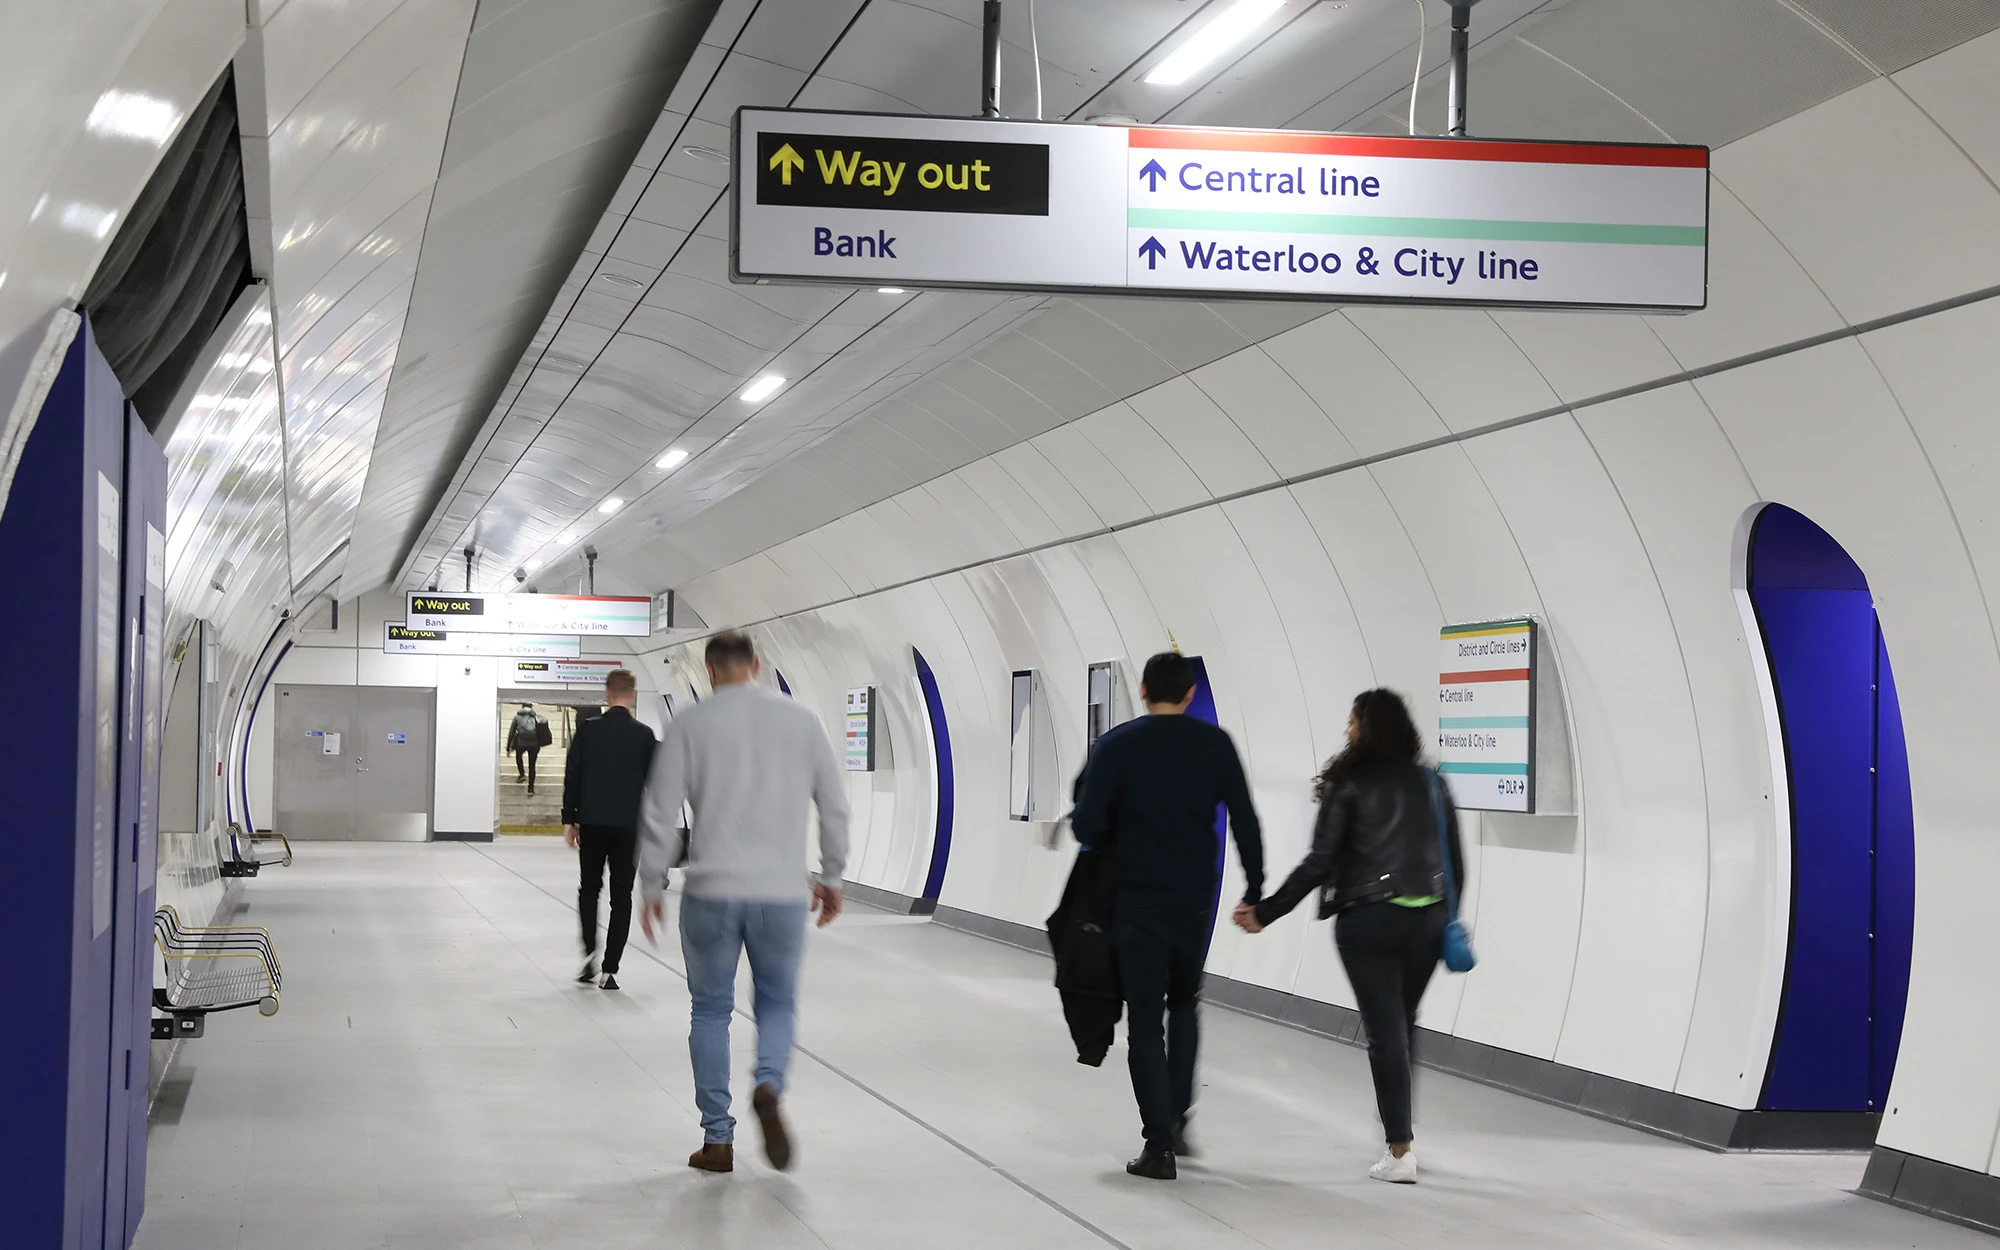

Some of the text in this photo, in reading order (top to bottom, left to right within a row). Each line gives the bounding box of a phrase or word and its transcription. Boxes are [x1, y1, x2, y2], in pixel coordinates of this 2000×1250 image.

[814, 149, 991, 196] Way out
[1178, 162, 1380, 198] Central line
[813, 226, 897, 259] Bank
[1179, 240, 1539, 285] Waterloo & City line
[426, 600, 470, 612] Way out
[425, 618, 446, 627] Bank
[571, 622, 590, 632] City
[592, 622, 608, 631] line
[516, 645, 531, 654] City
[1458, 640, 1520, 657] District and Circle lines
[1444, 688, 1473, 702] Central line
[1444, 733, 1496, 750] Waterloo & City line
[1505, 780, 1517, 794] DLR
